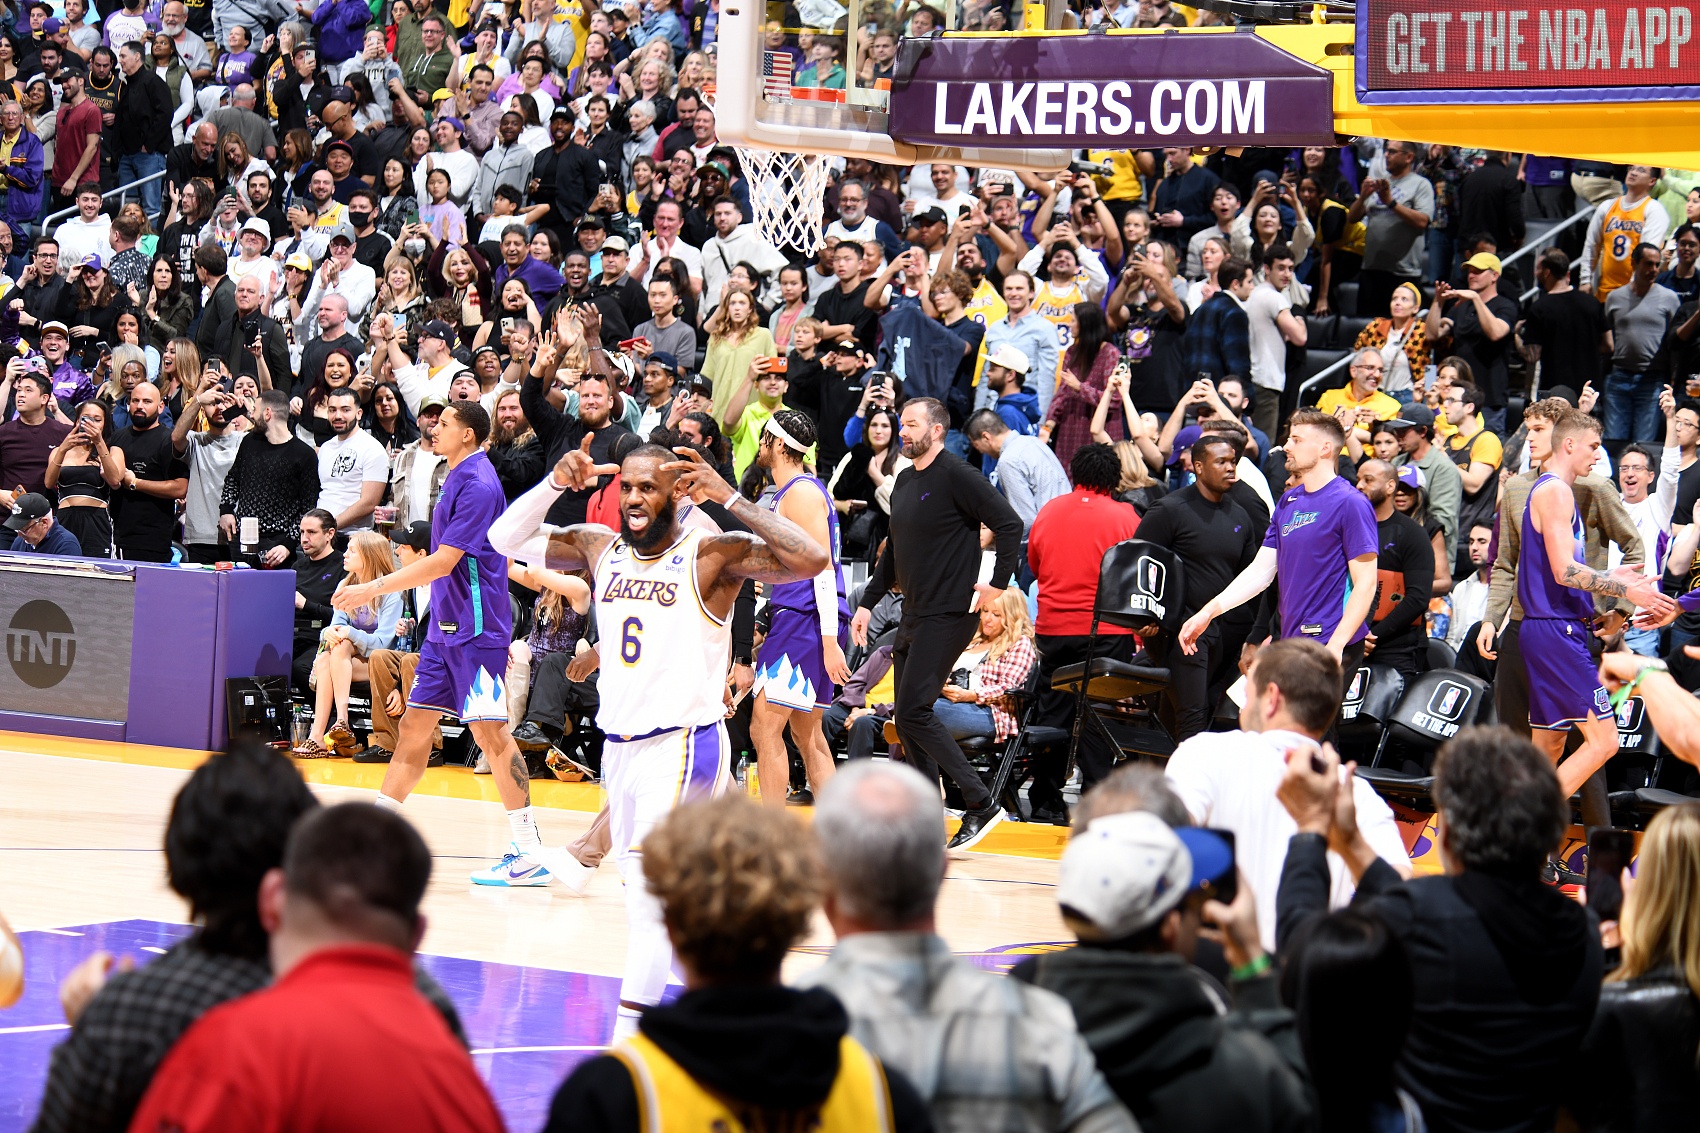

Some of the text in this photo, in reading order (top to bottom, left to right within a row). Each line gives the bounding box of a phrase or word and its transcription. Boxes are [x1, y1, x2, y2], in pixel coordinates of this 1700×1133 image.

[1387, 6, 1692, 74] GET THE NBA APP
[934, 80, 1266, 135] LAKERS.COM
[1605, 216, 1643, 234] LAKERS
[1612, 235, 1627, 257] 8
[665, 565, 686, 574] bibigo
[601, 571, 679, 607] LAKERS
[1130, 593, 1148, 610] GET
[7, 627, 76, 667] TNT
[621, 615, 643, 668] 6
[1411, 710, 1460, 738] GET THE APP
[1625, 734, 1643, 748] APP
